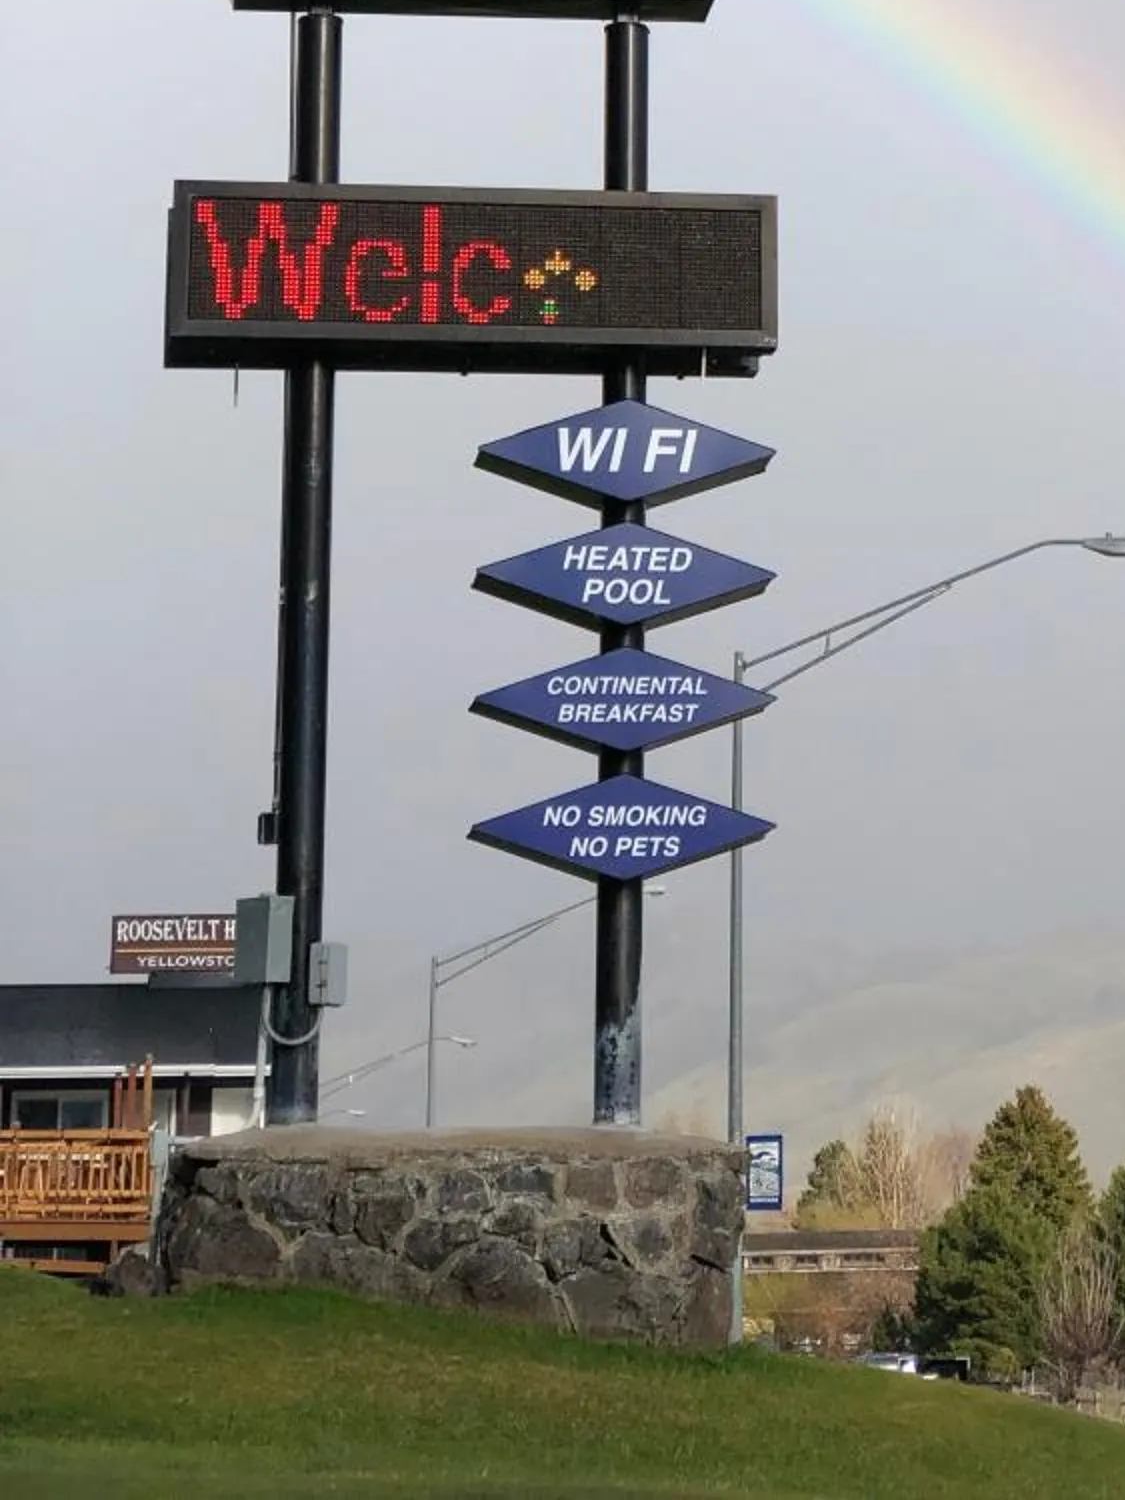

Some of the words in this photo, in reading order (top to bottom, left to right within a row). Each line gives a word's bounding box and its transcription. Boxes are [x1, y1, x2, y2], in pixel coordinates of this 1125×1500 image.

[557, 427, 629, 473] WI
[643, 429, 699, 474] FI
[562, 545, 694, 572] HEATED
[581, 578, 672, 604] POOL
[546, 675, 709, 696] CONTINENTAL
[557, 703, 699, 723] BREAKFAST
[542, 805, 582, 828] NO
[587, 805, 708, 828] SMOKING
[569, 836, 609, 858] NO
[614, 836, 681, 858] PETS
[117, 916, 220, 942] ROOSEVELT
